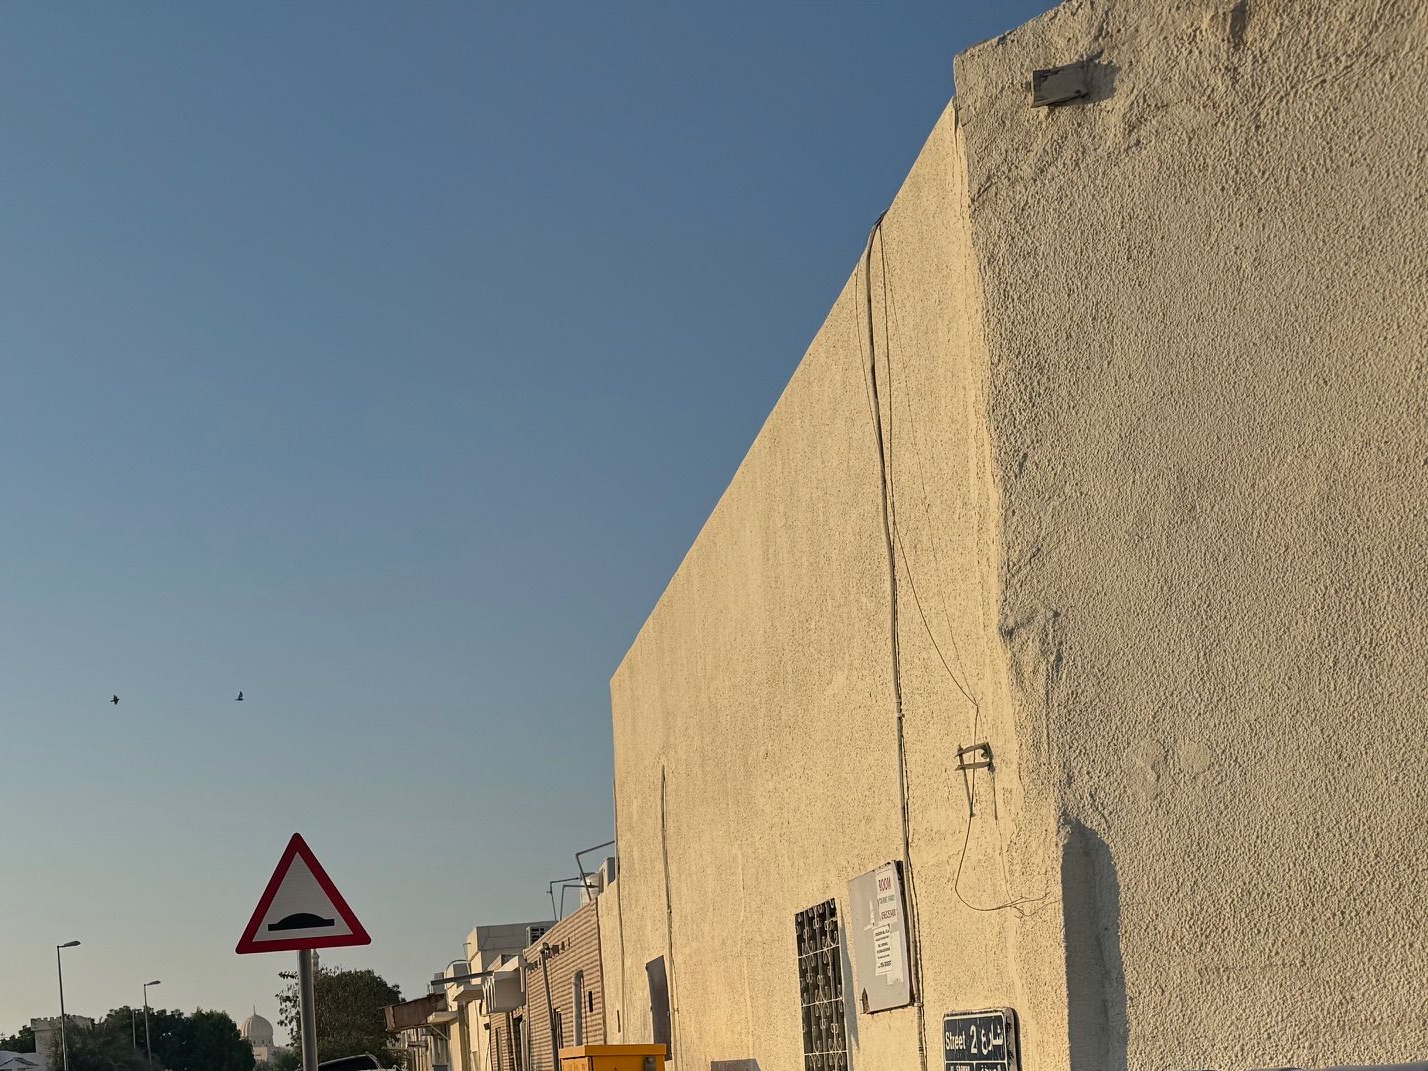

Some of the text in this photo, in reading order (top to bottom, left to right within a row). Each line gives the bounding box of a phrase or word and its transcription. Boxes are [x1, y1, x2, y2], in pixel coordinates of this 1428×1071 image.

[945, 1025, 978, 1053] Street 2
[981, 1022, 1003, 1055] شارع
